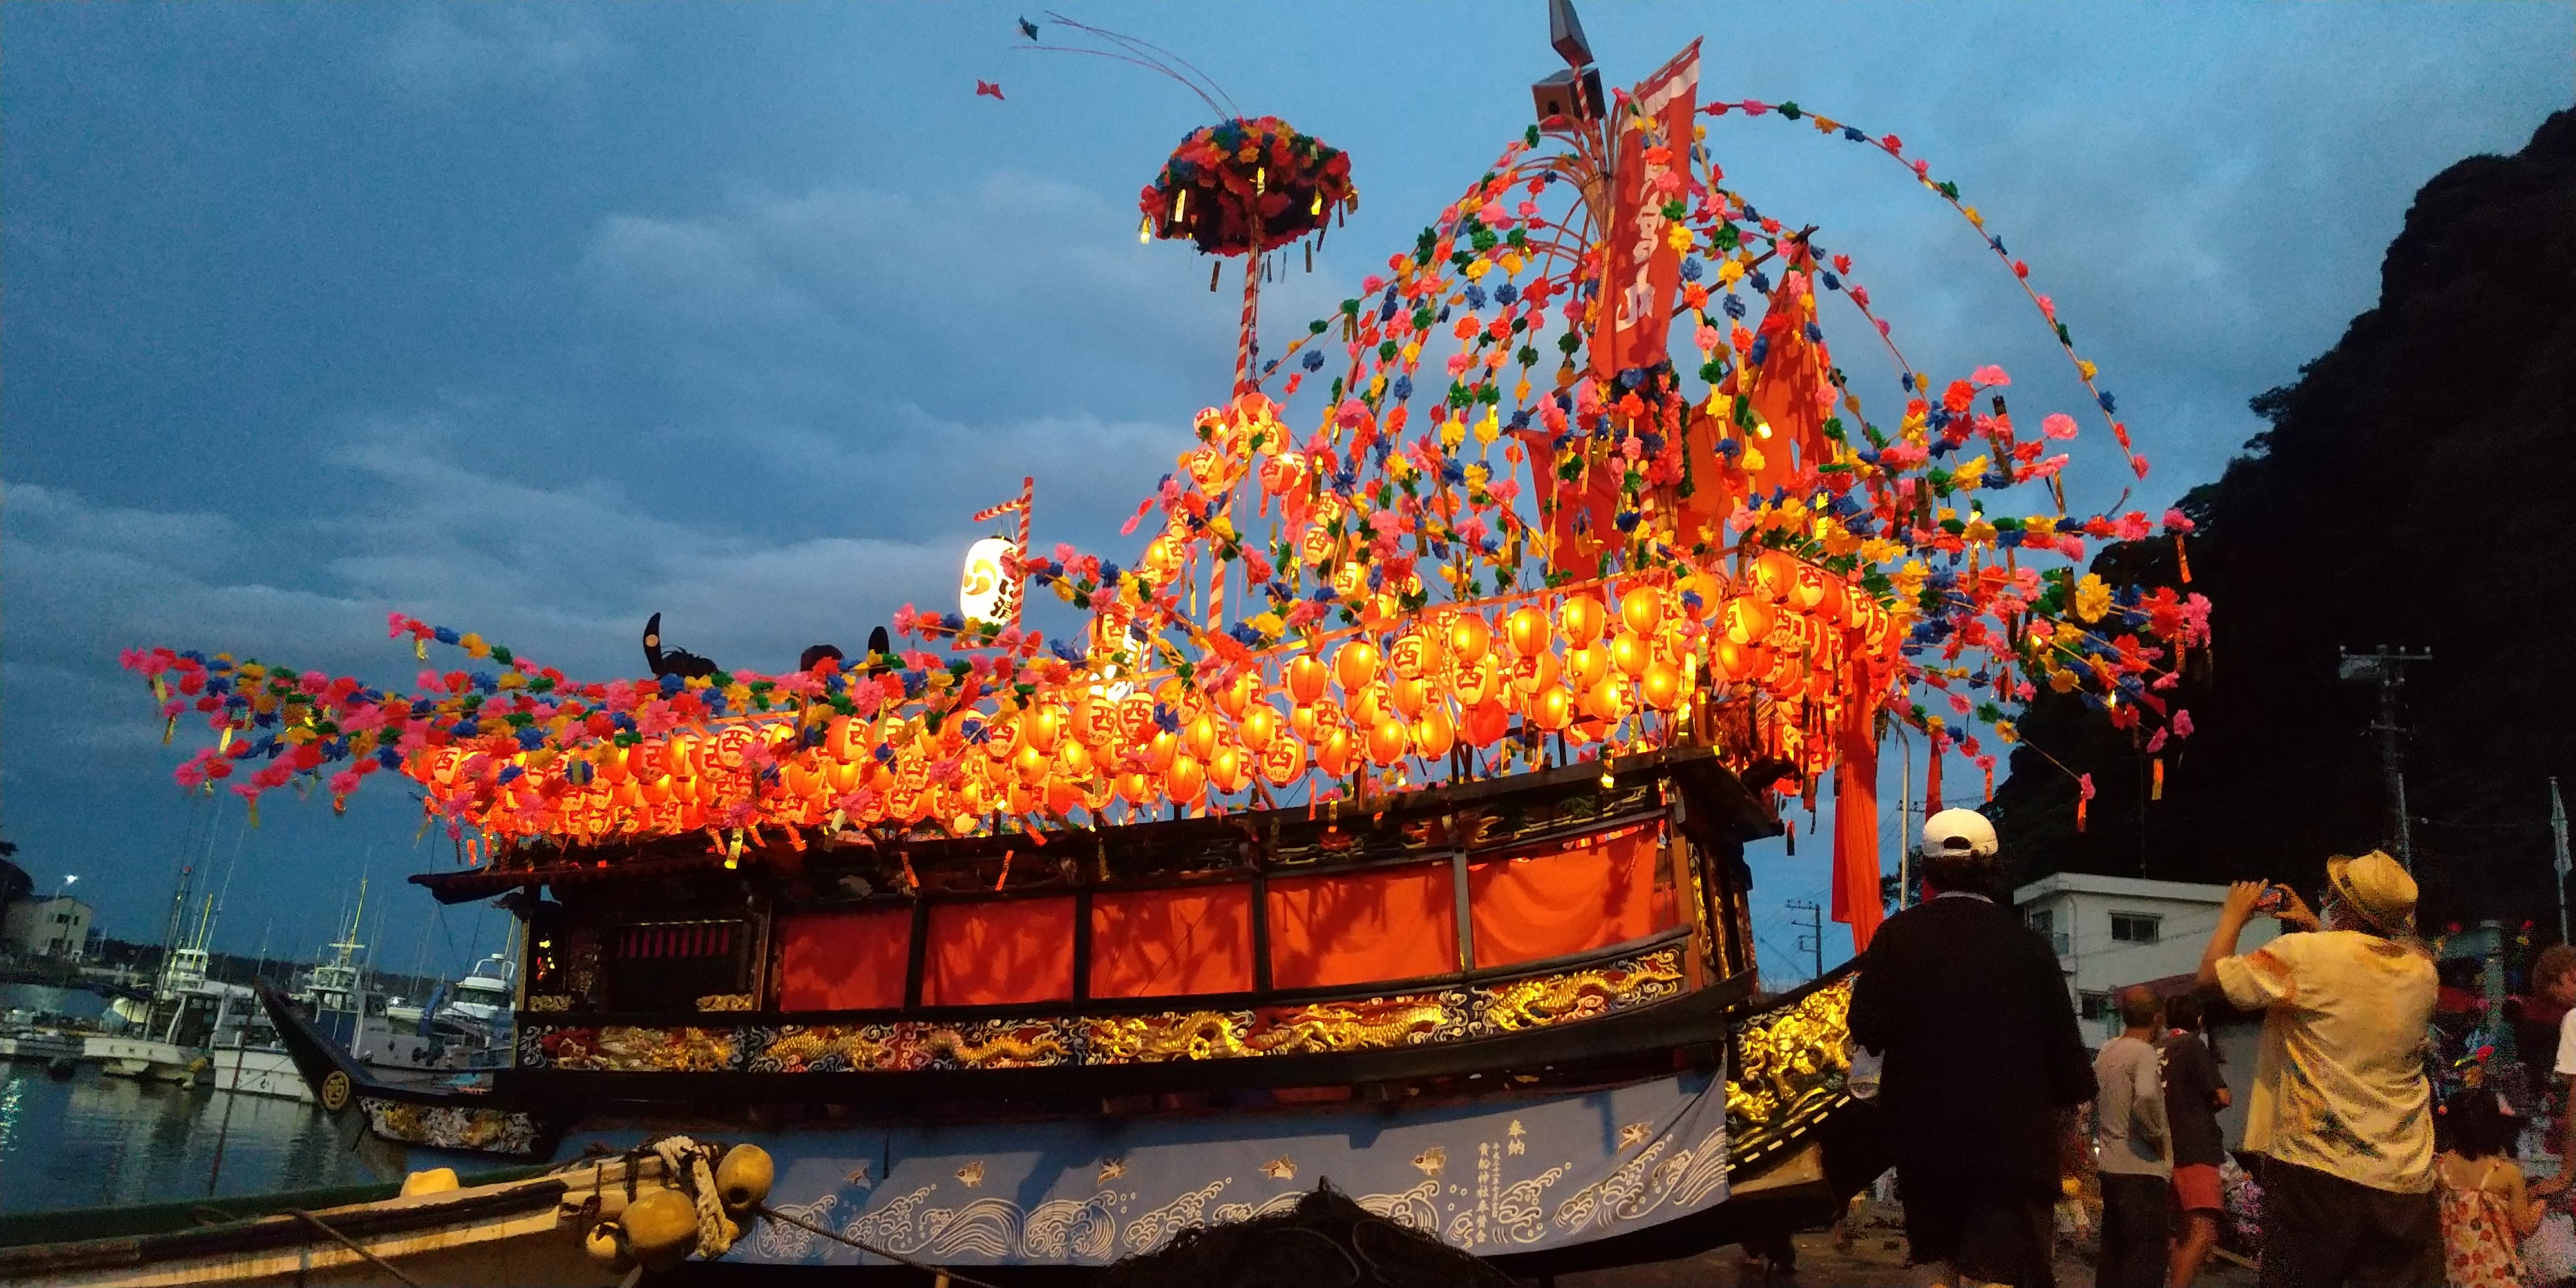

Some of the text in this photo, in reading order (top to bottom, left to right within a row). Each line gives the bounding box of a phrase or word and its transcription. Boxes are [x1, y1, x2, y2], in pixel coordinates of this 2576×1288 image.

[1307, 531, 1328, 551] 西
[1393, 641, 1421, 668] 西
[1456, 663, 1486, 690] 西
[1091, 708, 1117, 734] 西
[1121, 699, 1153, 724] 西
[1316, 701, 1339, 727] 西
[723, 730, 752, 752] 西
[435, 752, 458, 771] 西
[1267, 743, 1296, 769] 西
[1508, 1119, 1526, 1156] 奉納
[1475, 1142, 1491, 1244] 貴船神社奉賛会
